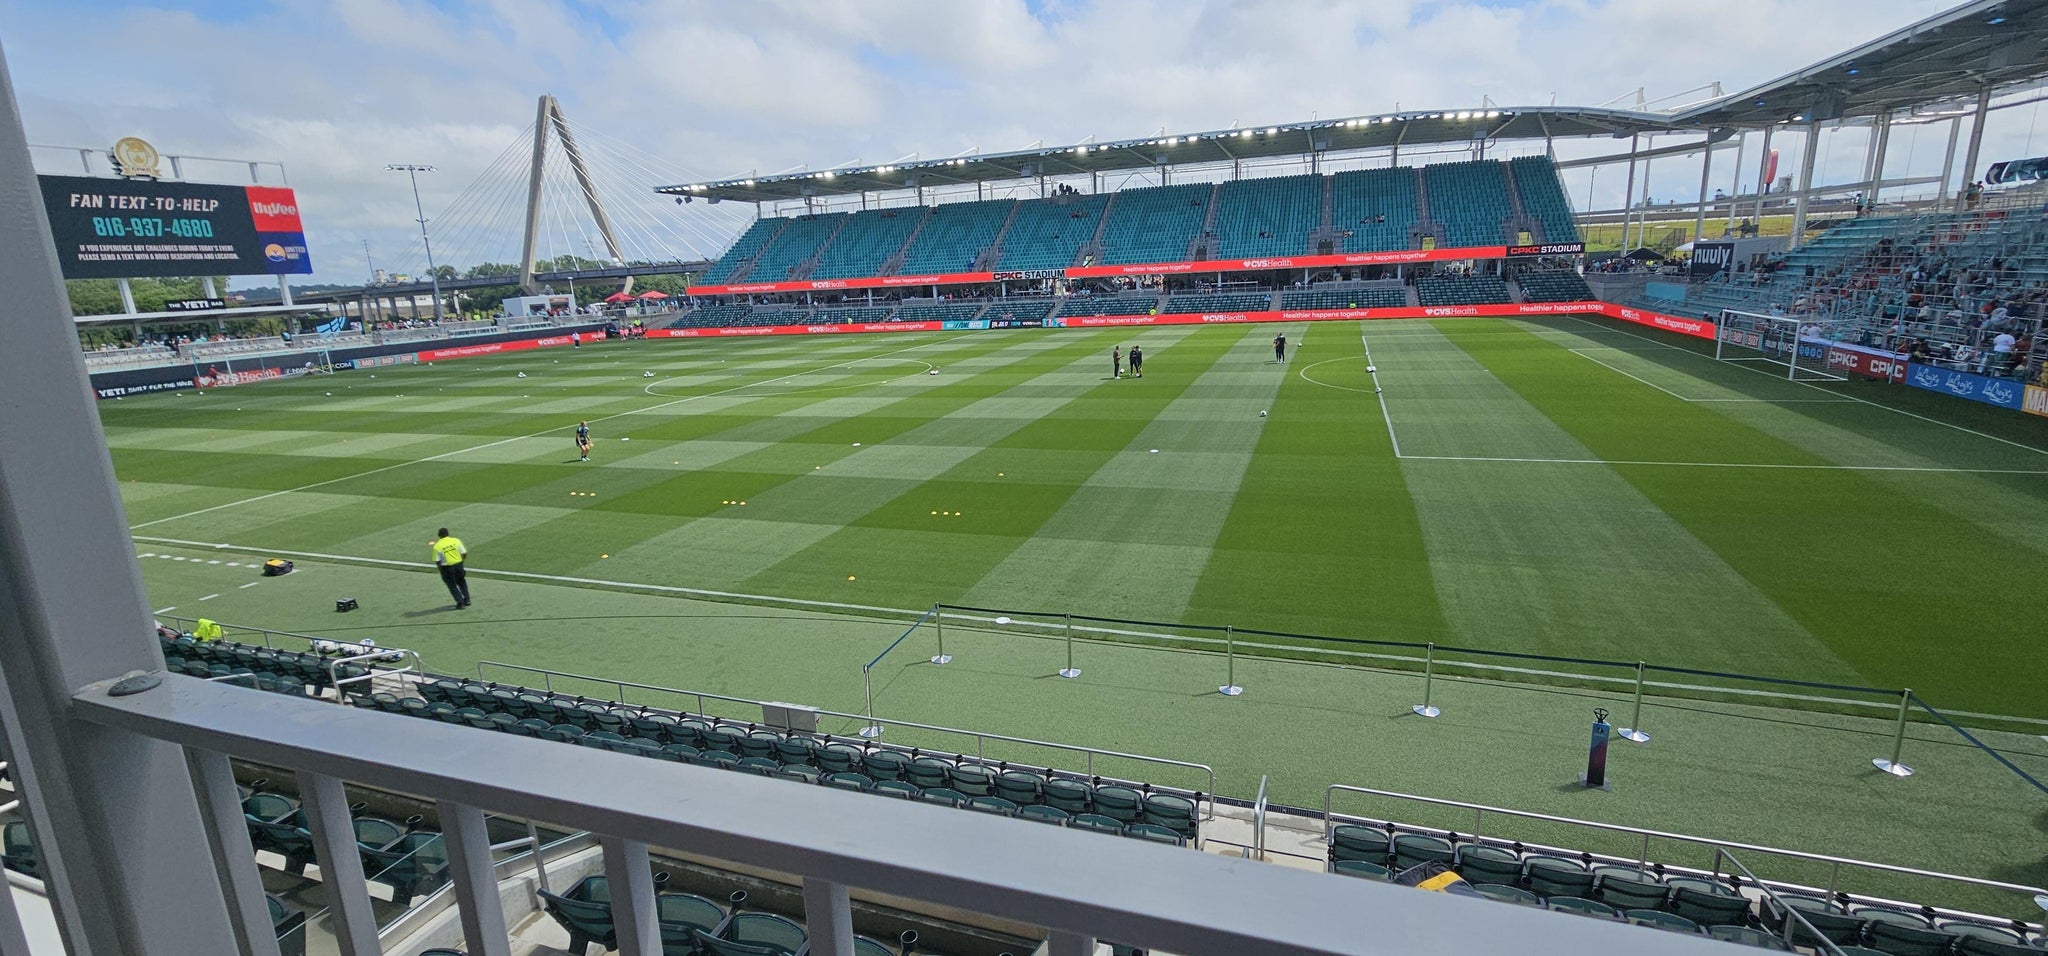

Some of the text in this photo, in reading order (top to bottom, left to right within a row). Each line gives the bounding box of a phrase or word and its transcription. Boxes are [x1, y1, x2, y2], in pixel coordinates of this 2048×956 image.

[70, 193, 103, 208] FAN
[92, 216, 213, 238] 816-937-4680
[1509, 244, 1581, 255] CPKC STADIUM
[1345, 251, 1428, 262] Healthier happens together
[1694, 245, 1731, 269] nuuly
[1148, 265, 1169, 273] happens
[993, 269, 1065, 281] CPKC STADIUM
[182, 300, 209, 309] YETI
[1520, 304, 1553, 313] Healthier
[1554, 304, 1587, 312] happens
[1312, 311, 1339, 320] happens
[1340, 310, 1369, 318] together
[1107, 317, 1131, 325] happens
[1870, 359, 1904, 378] CPKC
[98, 387, 126, 397] YETI
